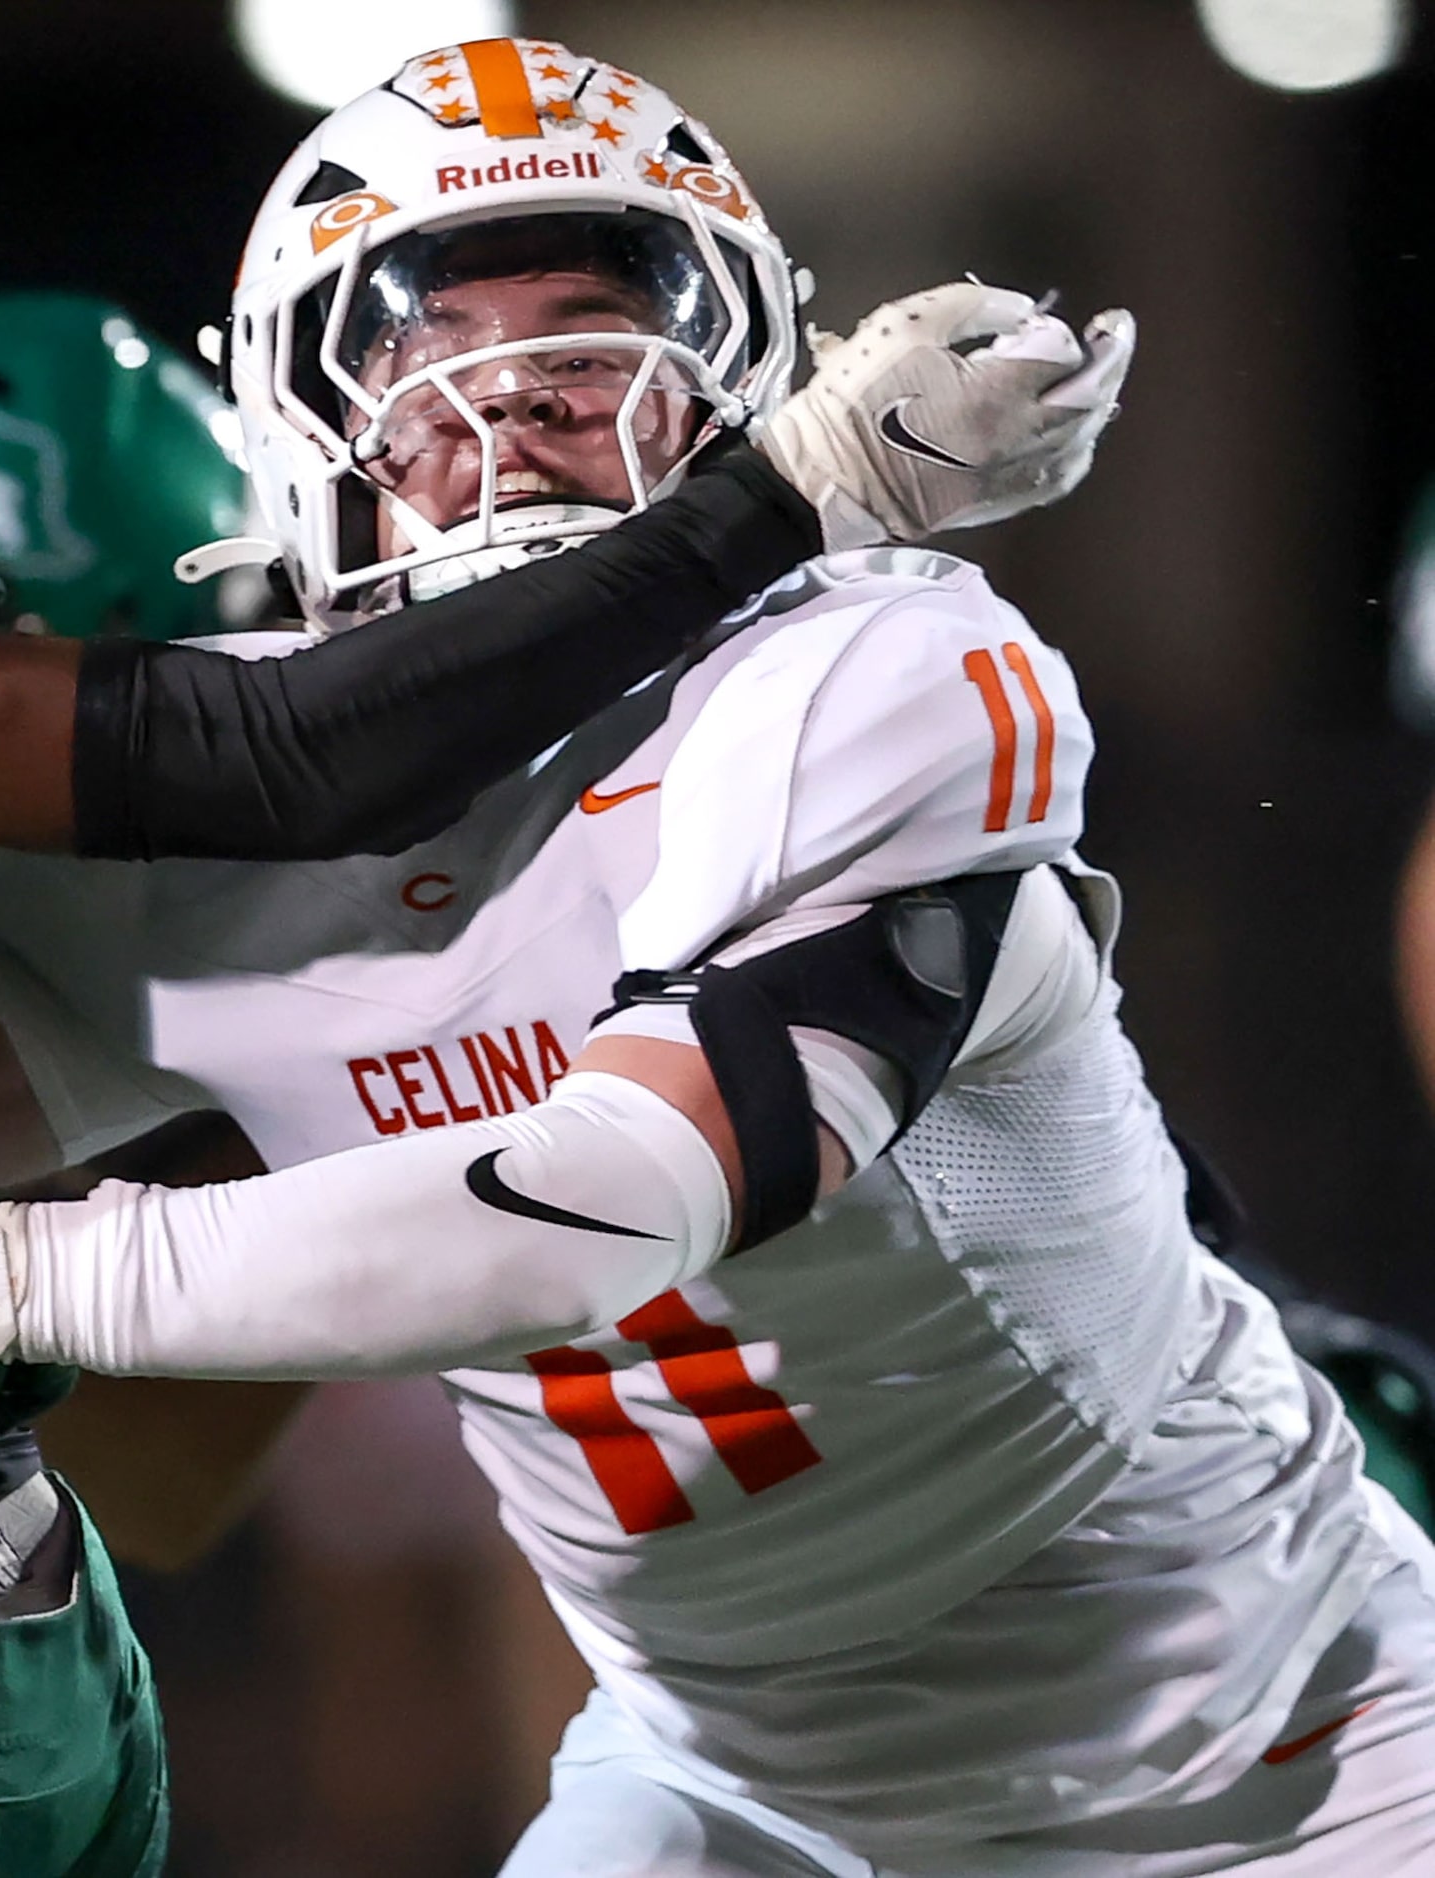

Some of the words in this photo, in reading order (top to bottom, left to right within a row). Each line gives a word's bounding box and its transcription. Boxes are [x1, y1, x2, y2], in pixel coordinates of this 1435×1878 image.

[436, 152, 600, 194] Riddell
[962, 641, 1055, 833] 11
[346, 1020, 570, 1135] CELINA
[524, 1288, 822, 1536] 11
